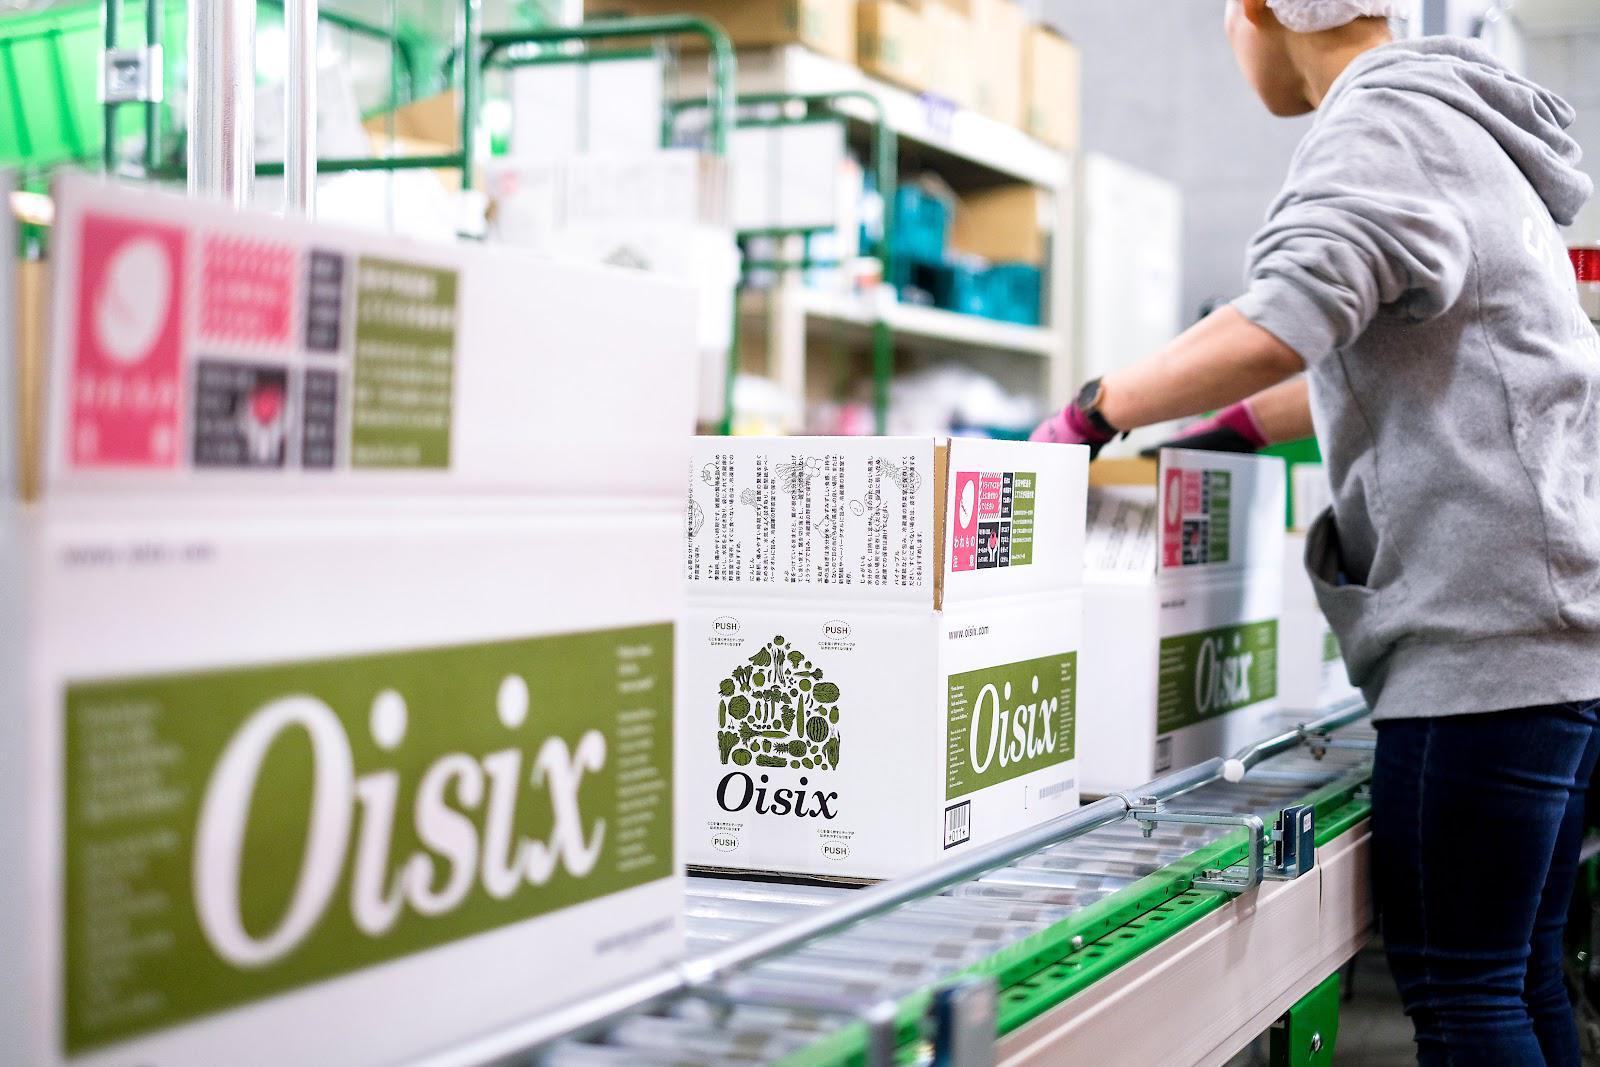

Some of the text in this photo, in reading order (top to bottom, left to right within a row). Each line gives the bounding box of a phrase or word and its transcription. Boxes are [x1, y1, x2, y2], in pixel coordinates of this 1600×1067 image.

[715, 622, 737, 630] PUSH
[825, 626, 848, 635] PUSH
[969, 674, 1058, 776] Oisix
[716, 771, 838, 820] Oisix
[192, 673, 608, 971] Oisix
[714, 838, 736, 847] PUSH
[824, 846, 847, 855] PUSH
